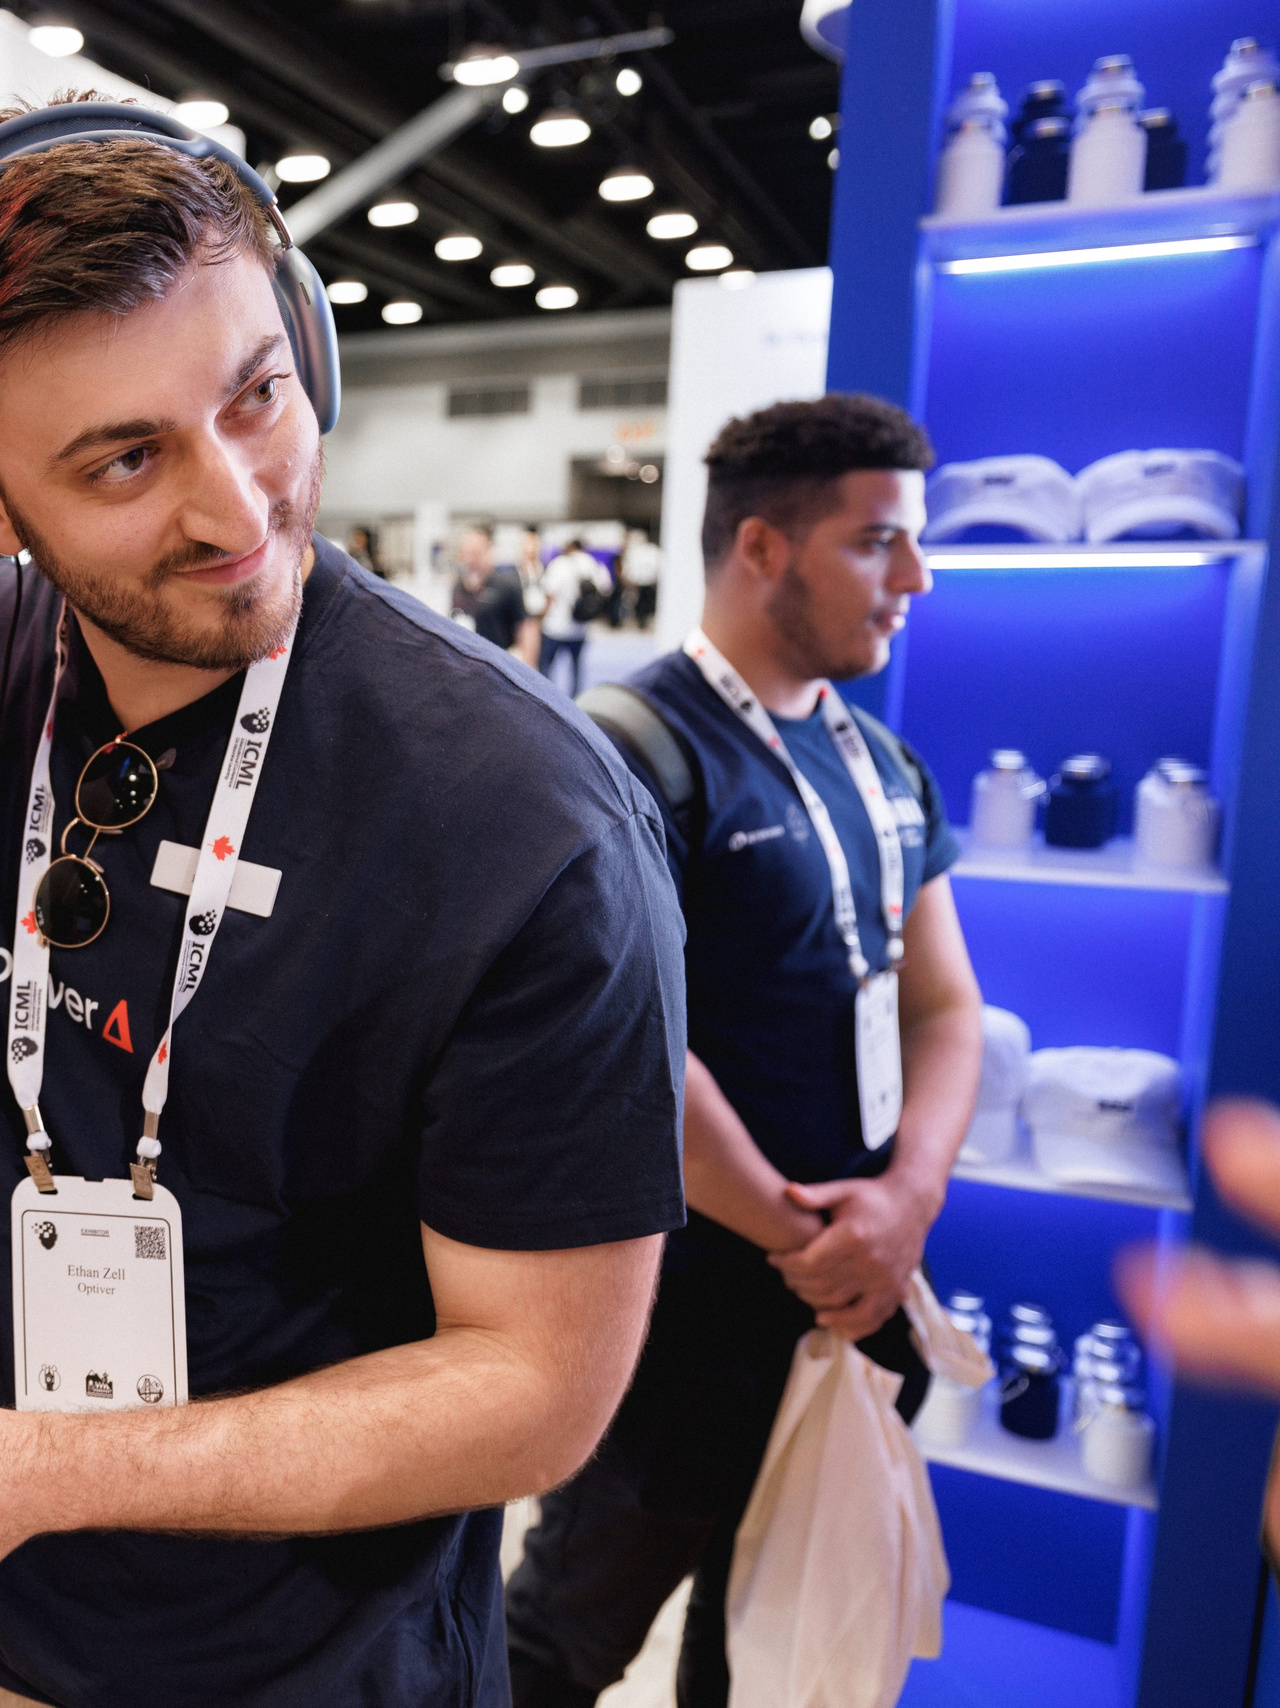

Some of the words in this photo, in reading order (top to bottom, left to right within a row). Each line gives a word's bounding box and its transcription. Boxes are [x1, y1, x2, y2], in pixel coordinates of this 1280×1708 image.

[235, 740, 262, 789] ICML
[29, 784, 45, 832] ICML
[179, 942, 205, 993] ICML
[15, 981, 30, 1030] ICML
[68, 1264, 99, 1278] Ethan
[103, 1267, 125, 1280] Zell
[77, 1282, 115, 1296] Optiver
